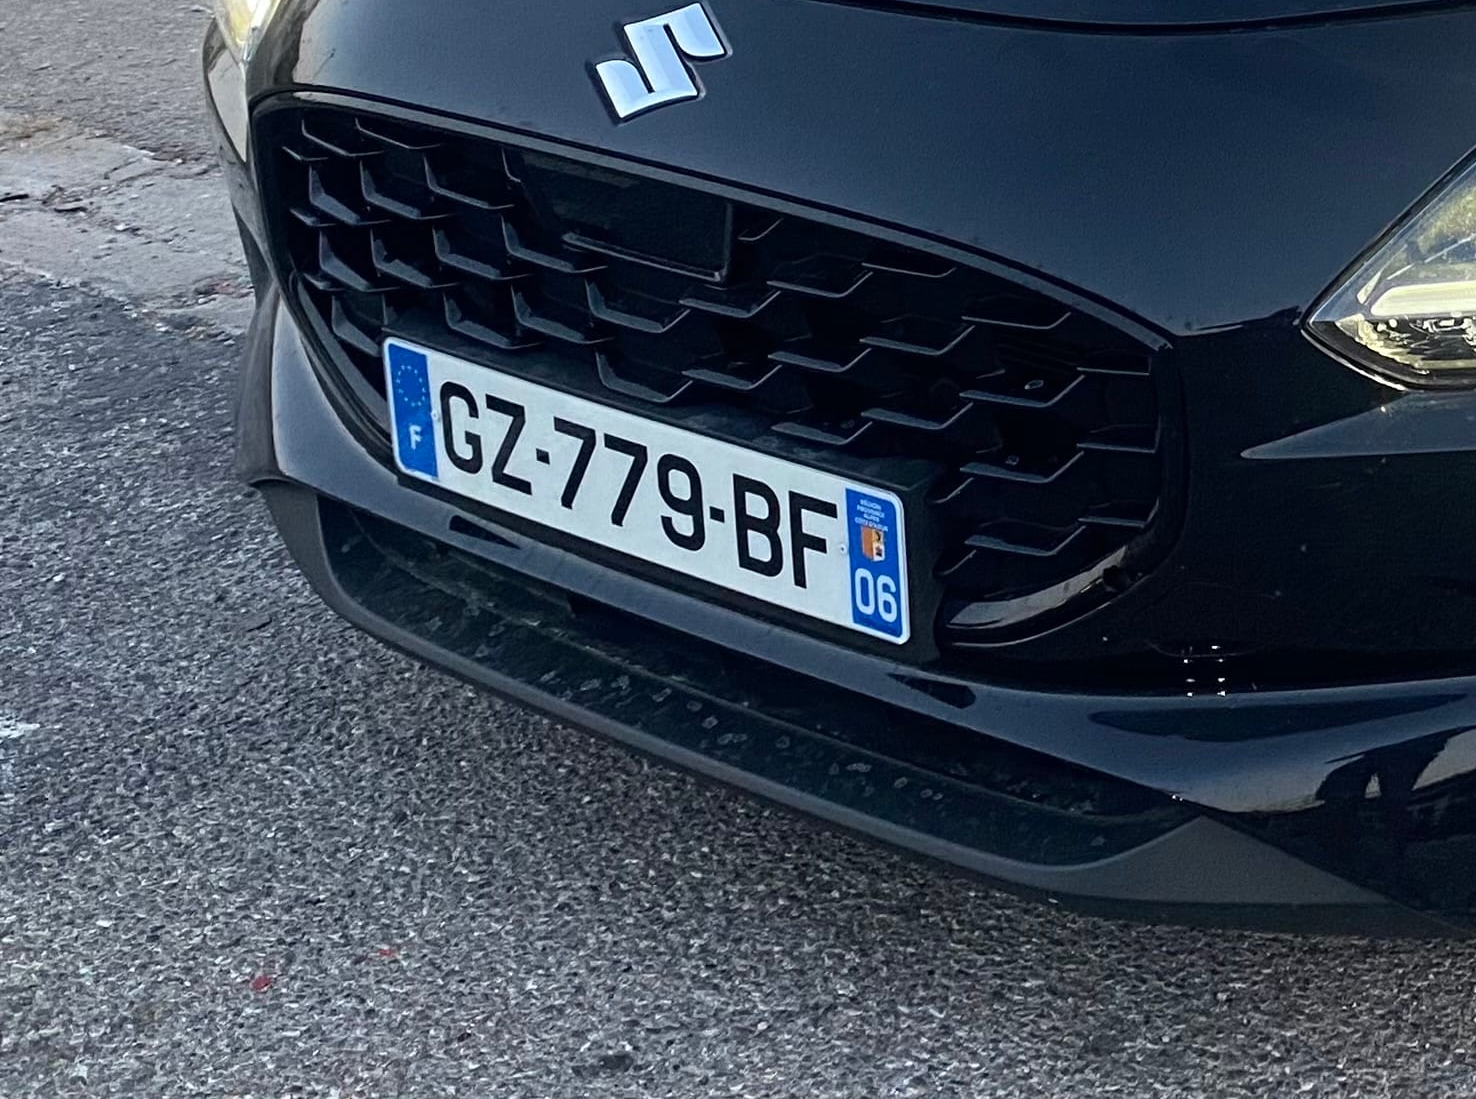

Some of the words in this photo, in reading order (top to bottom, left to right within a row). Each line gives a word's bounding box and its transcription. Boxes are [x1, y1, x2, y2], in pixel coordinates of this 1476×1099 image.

[410, 425, 421, 450] F
[440, 382, 838, 589] GZ-779-BF
[855, 568, 898, 622] 06
